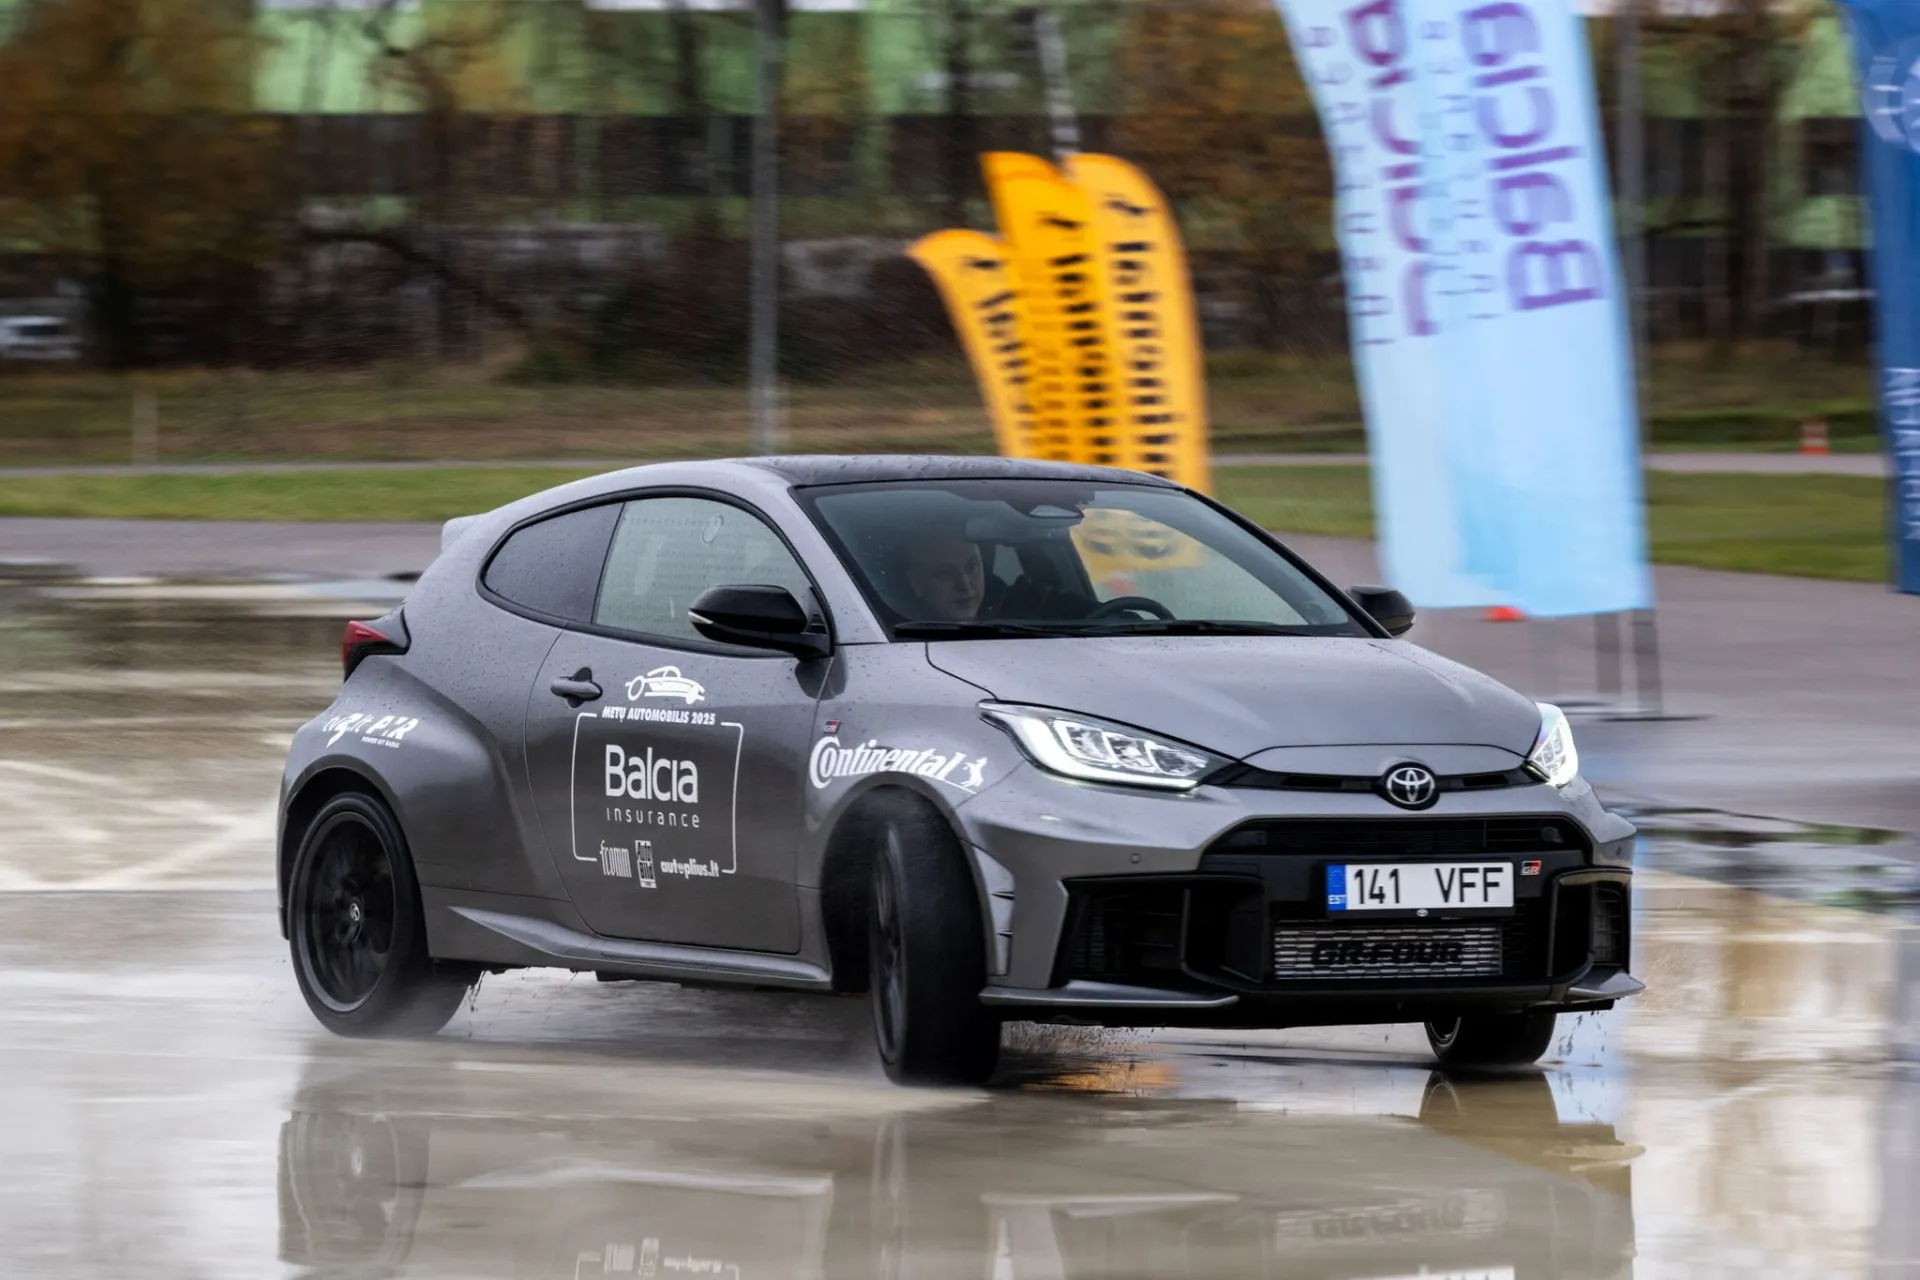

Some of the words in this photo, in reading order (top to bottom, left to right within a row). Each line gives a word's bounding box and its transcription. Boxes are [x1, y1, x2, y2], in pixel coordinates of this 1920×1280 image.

[602, 706, 626, 722] METŲ
[627, 708, 690, 723] AUTOMOBILIS
[691, 711, 716, 725] 2025
[606, 744, 698, 803] Balcia
[809, 736, 967, 789] Continental
[606, 807, 700, 828] insurance
[660, 858, 719, 879] autoplius.lt
[1354, 868, 1401, 904] 141
[1435, 867, 1504, 902] VFF
